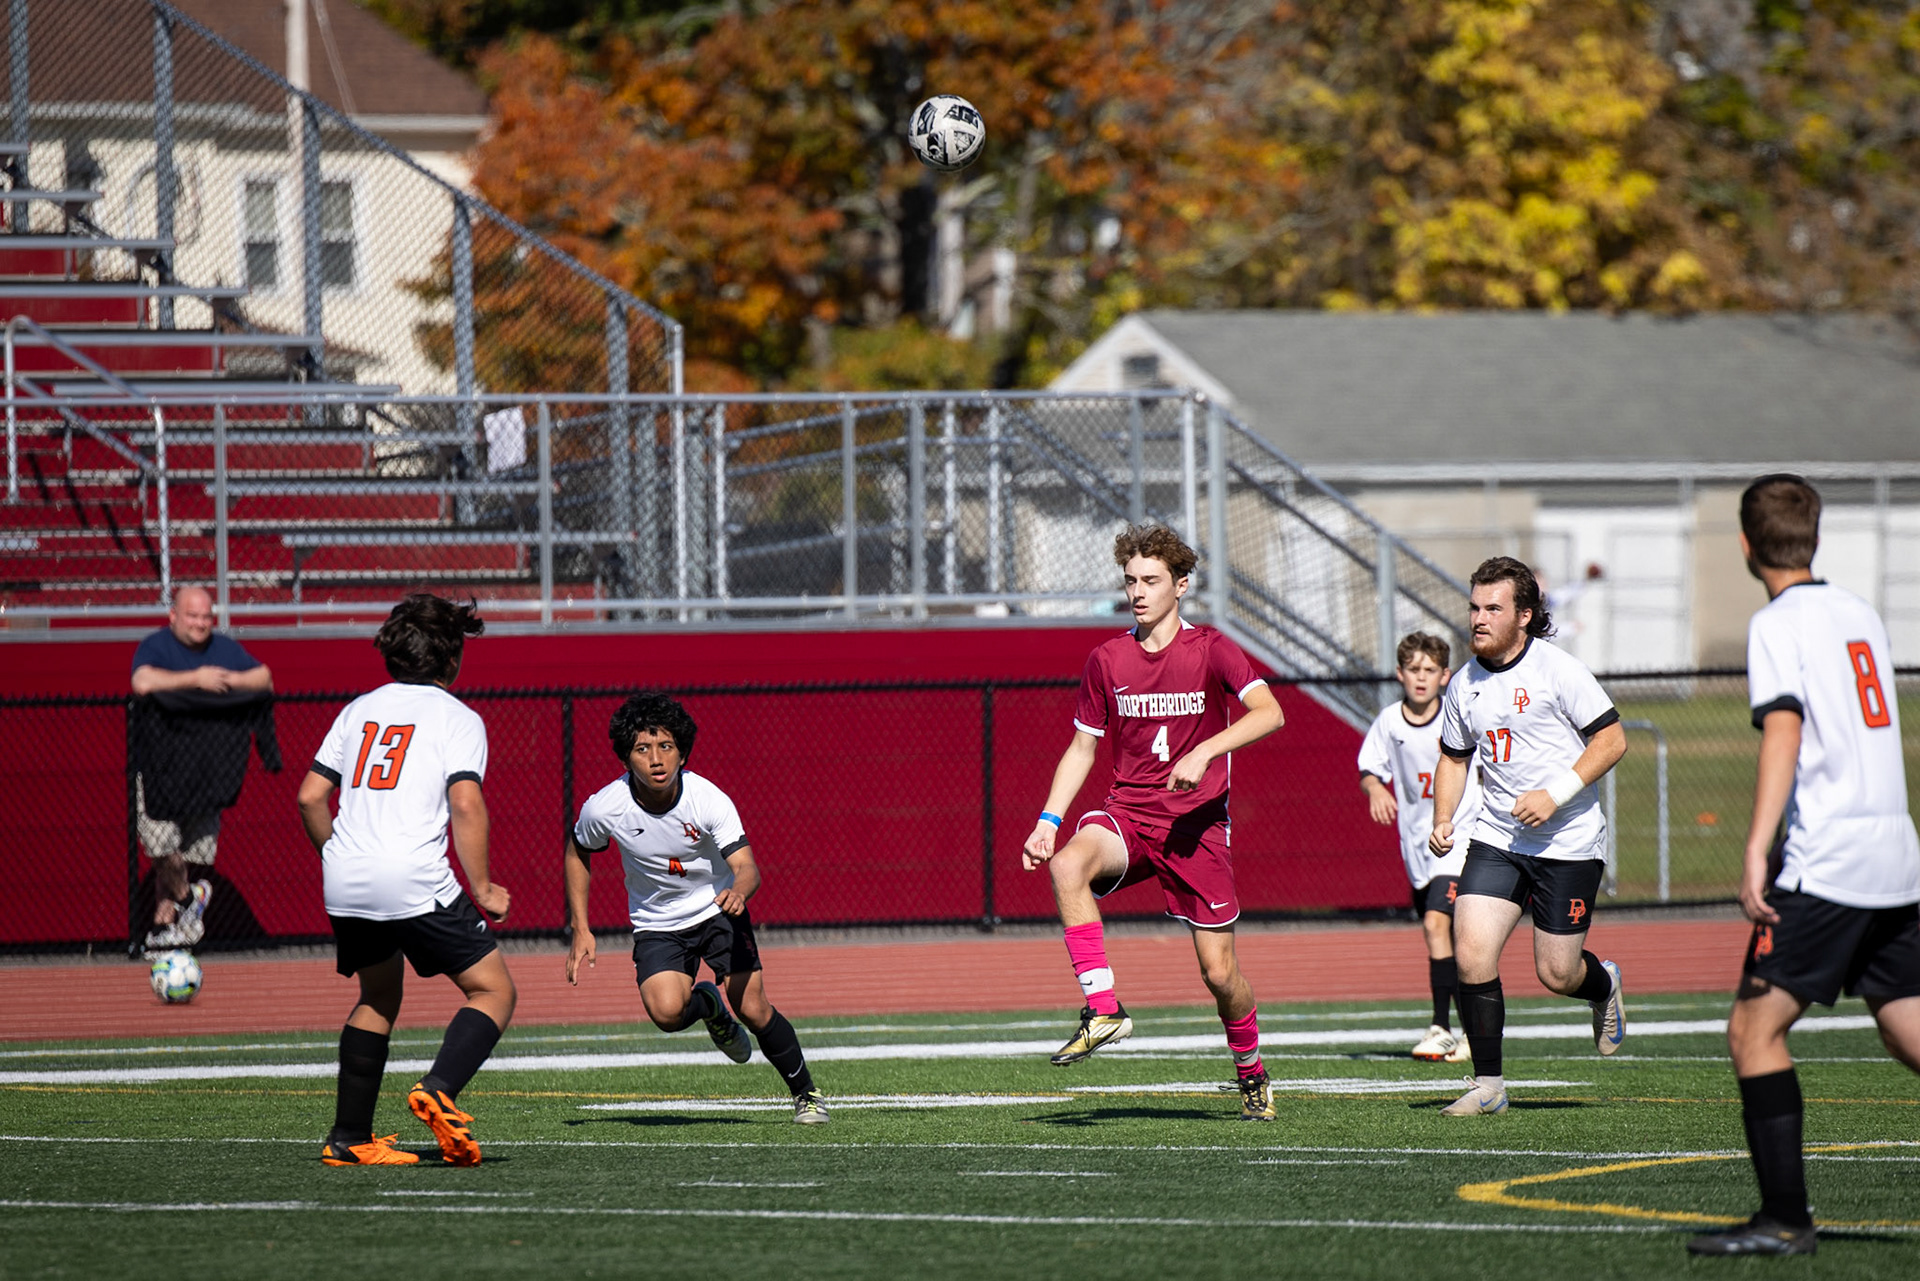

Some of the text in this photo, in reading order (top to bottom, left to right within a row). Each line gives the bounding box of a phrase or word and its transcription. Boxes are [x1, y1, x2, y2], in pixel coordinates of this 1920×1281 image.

[1846, 640, 1891, 728] 8
[1115, 691, 1205, 717] NORTHBRIDGE
[351, 721, 416, 790] 13
[1151, 725, 1170, 762] 4
[1486, 728, 1513, 763] 17
[668, 857, 687, 878] 4
